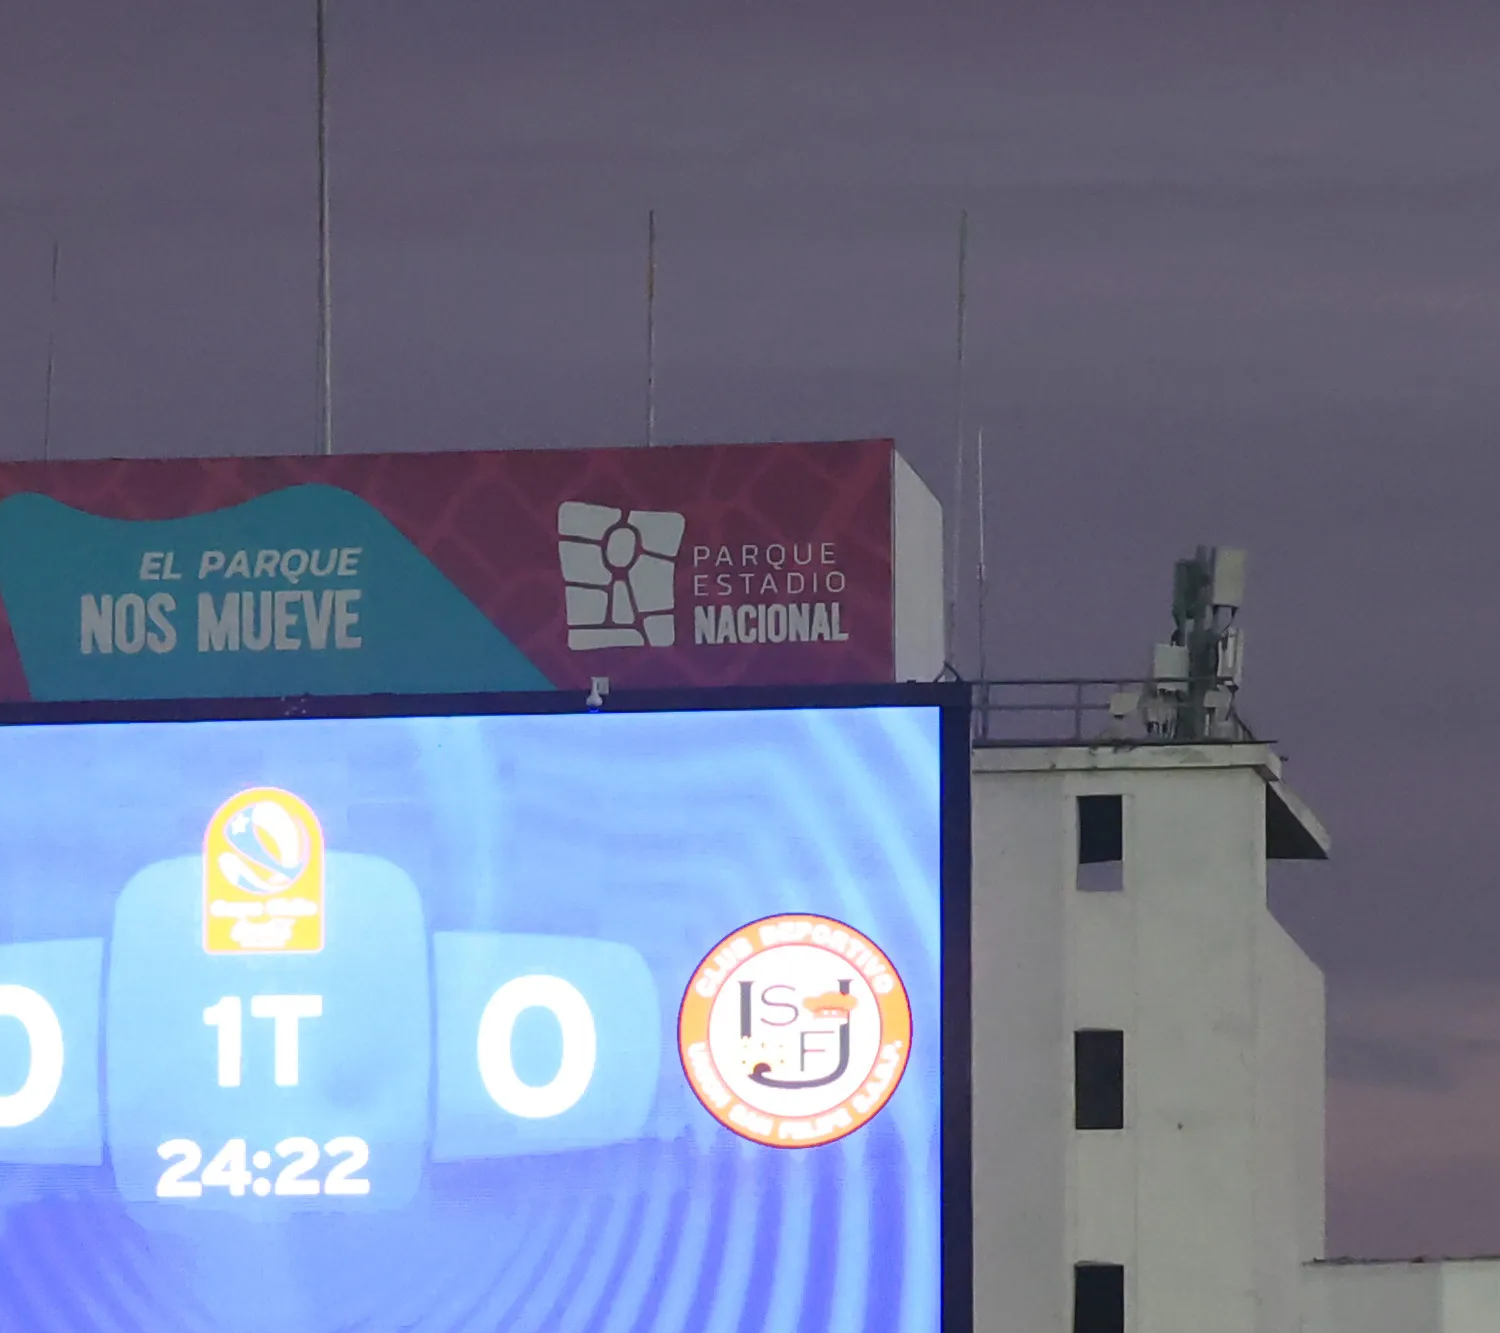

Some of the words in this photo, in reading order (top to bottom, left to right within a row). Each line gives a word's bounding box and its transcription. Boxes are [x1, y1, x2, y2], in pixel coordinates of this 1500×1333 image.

[140, 552, 182, 580] EL
[198, 547, 362, 584] PARQUE
[694, 543, 836, 570] PARQUE
[694, 571, 846, 596] ESTADIO
[80, 593, 177, 654] NOS
[198, 589, 362, 652] MUEVE
[695, 602, 849, 644] NACIONAL
[203, 995, 323, 1088] 1T
[476, 974, 596, 1119] 0
[156, 1136, 370, 1198] 24:22
